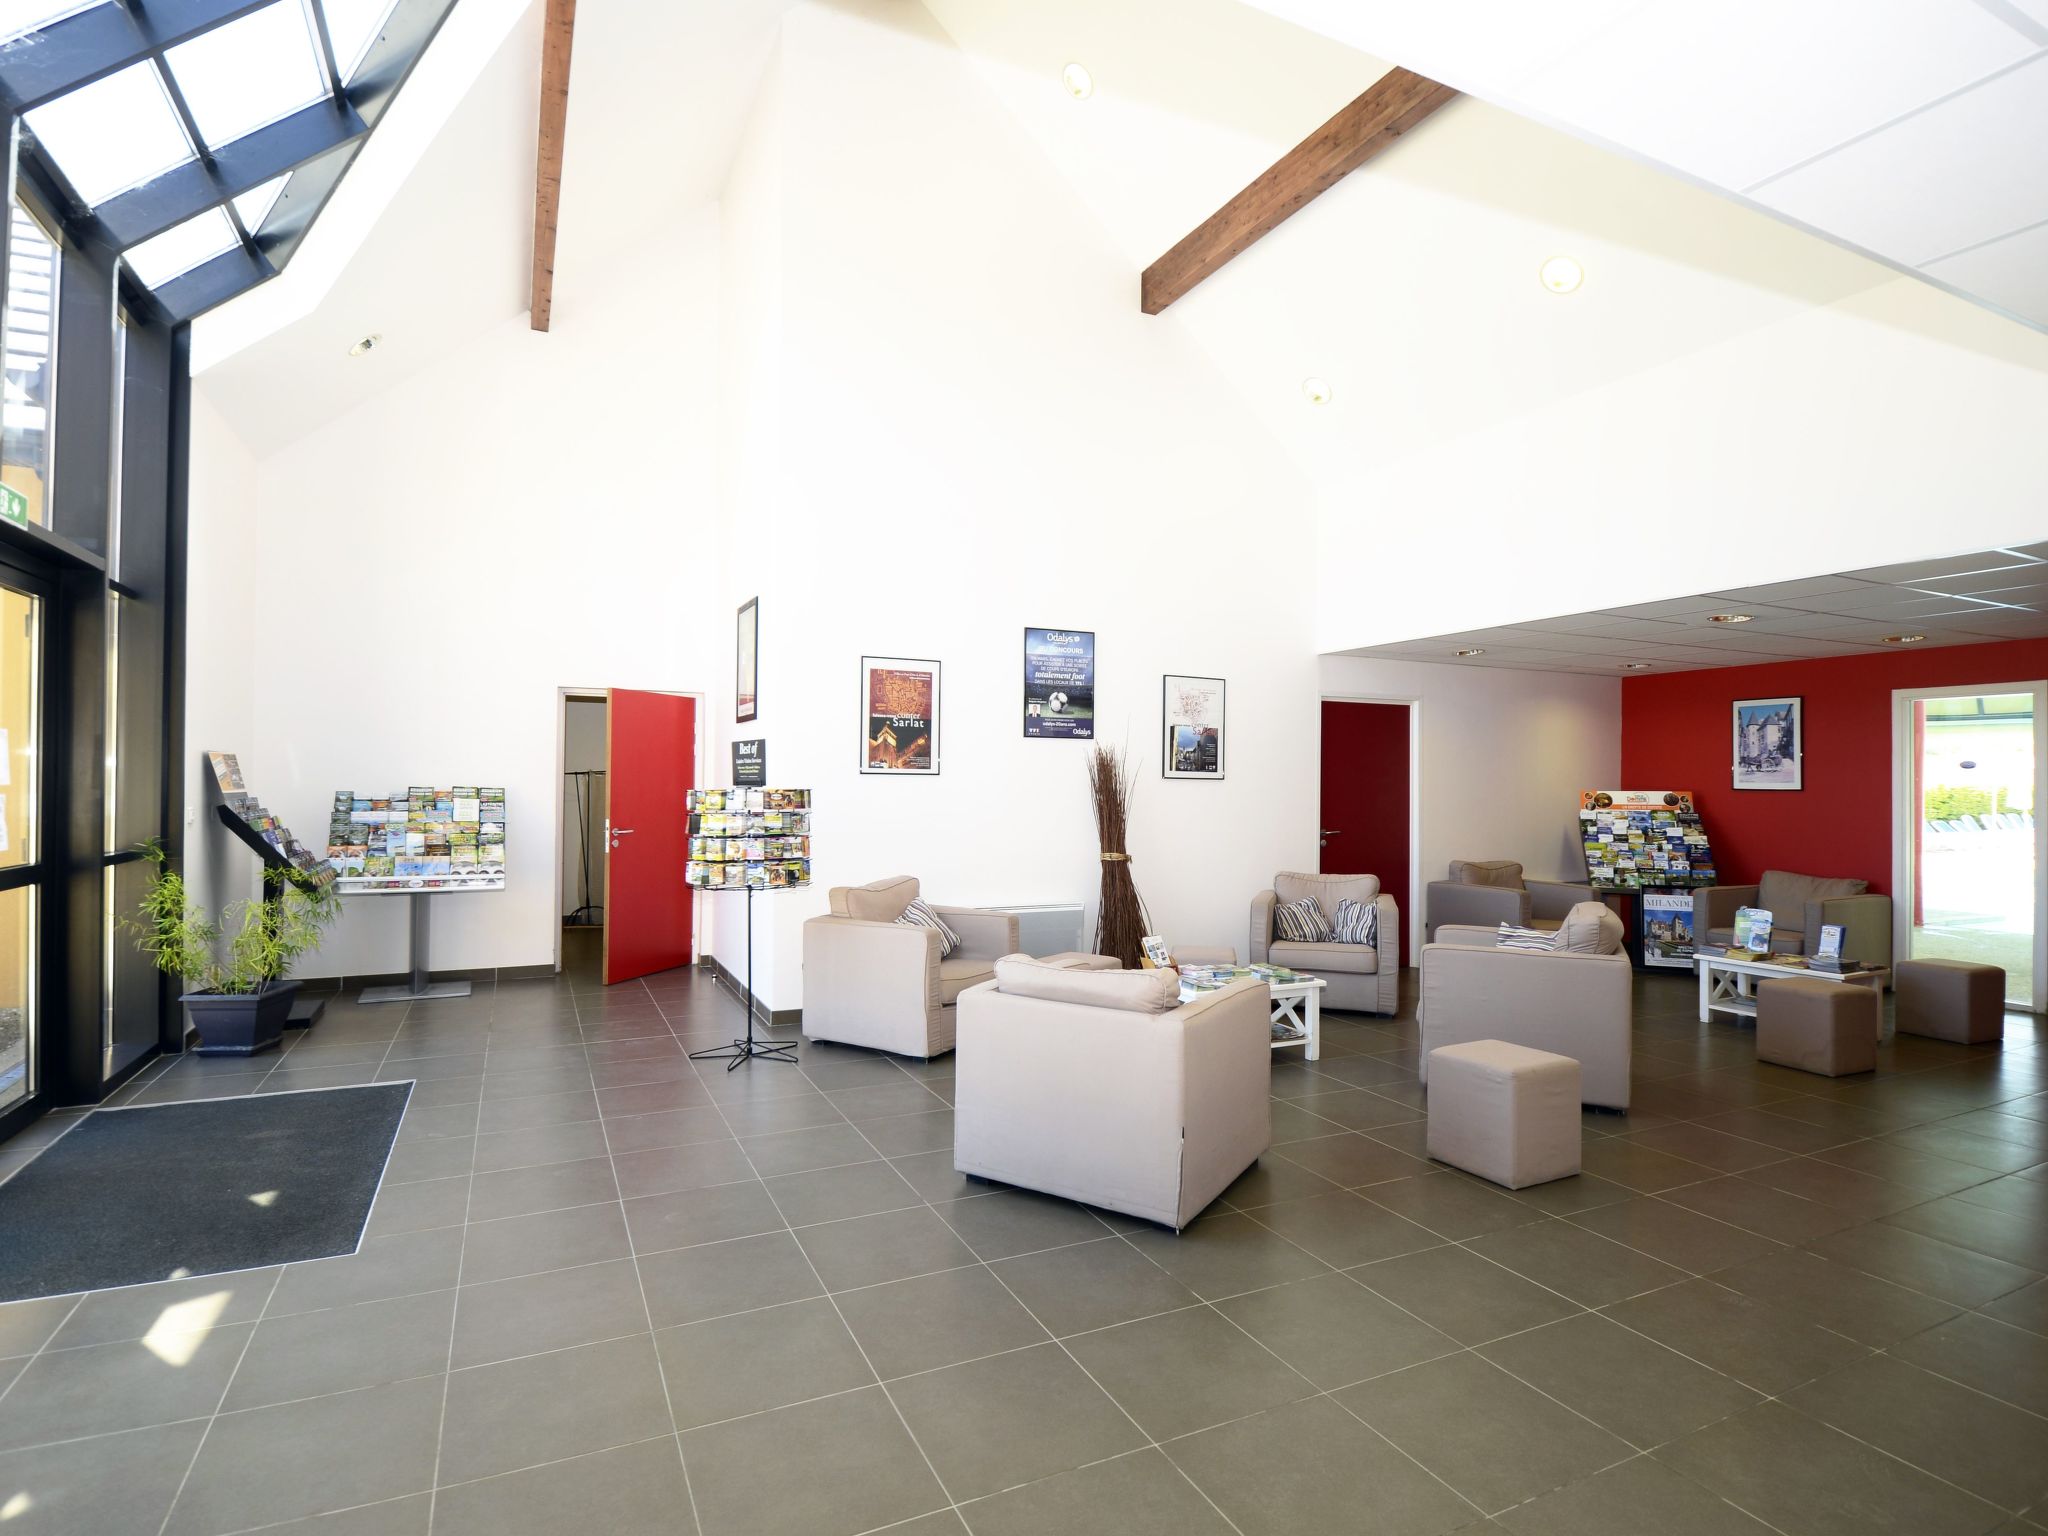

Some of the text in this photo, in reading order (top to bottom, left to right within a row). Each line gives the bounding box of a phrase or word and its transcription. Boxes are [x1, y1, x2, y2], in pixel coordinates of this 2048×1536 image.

[1047, 633, 1074, 645] Odalys
[1035, 671, 1086, 681] totalement foot
[892, 717, 925, 728] Sarlat
[1072, 728, 1092, 736] Odalys
[739, 743, 751, 754] Best
[1646, 898, 1693, 908] MILANDE
